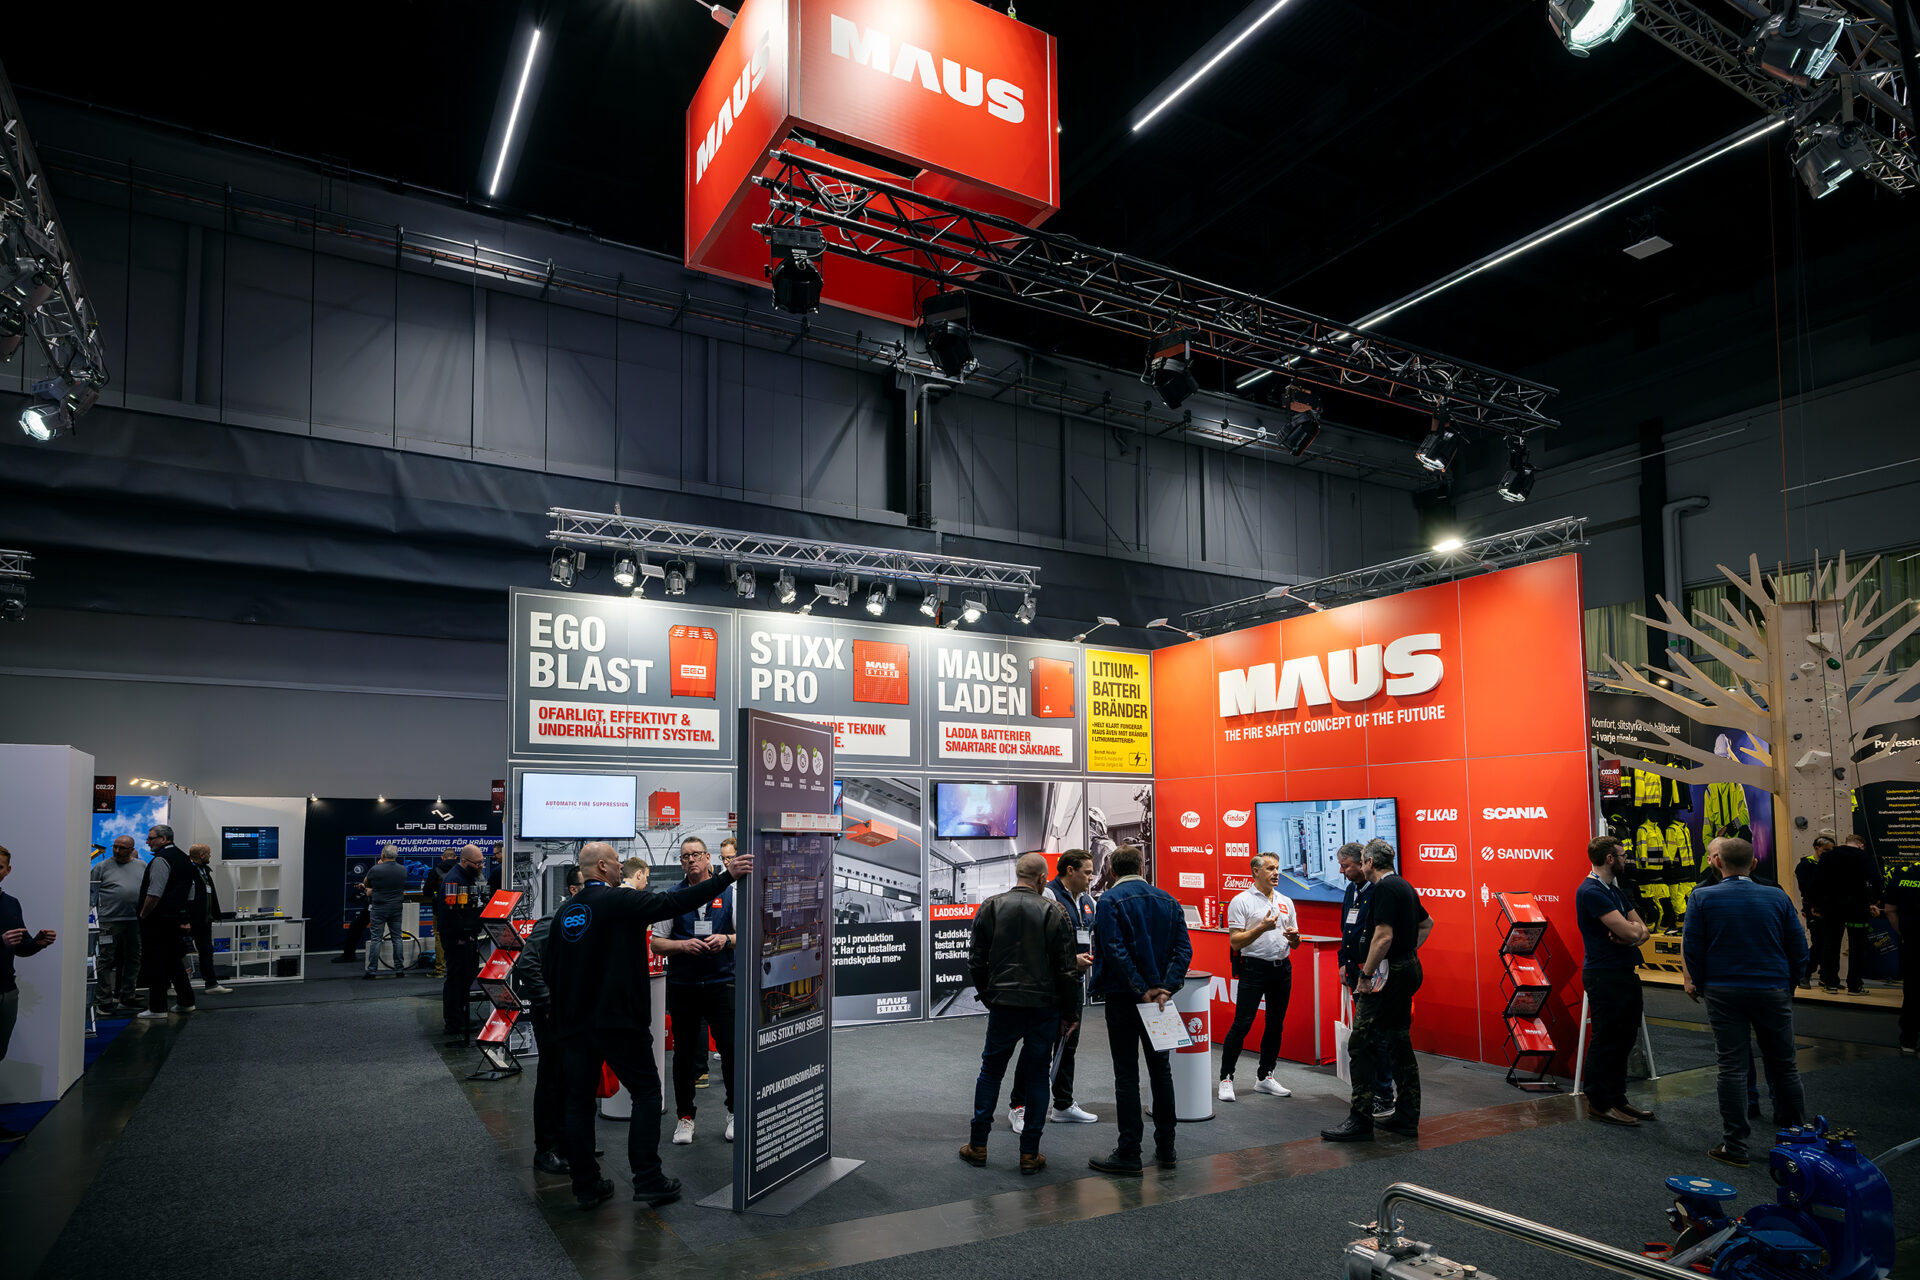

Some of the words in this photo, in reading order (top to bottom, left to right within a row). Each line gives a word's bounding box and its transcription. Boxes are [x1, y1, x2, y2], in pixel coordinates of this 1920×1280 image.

[831, 14, 1025, 124] MAUS
[696, 26, 770, 184] MAUS
[530, 612, 606, 652] EGO
[750, 631, 846, 670] STIXX
[866, 661, 895, 669] MAUS
[938, 648, 1018, 683] MAUS
[1092, 661, 1138, 679] LITIUM-
[530, 652, 654, 694] BLAST
[1218, 633, 1444, 718] MAUS
[752, 668, 818, 704] PRO
[1093, 680, 1140, 699] BATTERI
[938, 681, 1026, 716] LADEN
[538, 706, 606, 724] OFARLIGT,
[610, 710, 678, 725] EFFEKTIVT
[682, 714, 690, 726] &
[1093, 699, 1148, 719] BRÄNDER
[847, 722, 886, 736] TEKNIK
[1225, 729, 1241, 742] THE
[1244, 726, 1263, 740] FIRE
[1265, 722, 1301, 738] SAFETY
[1304, 716, 1351, 733] CONCEPT
[1355, 714, 1370, 727] OF
[1372, 711, 1394, 726] THE
[1397, 705, 1445, 722] FUTURE
[1592, 718, 1616, 730] Komfort,
[538, 721, 660, 740] UNDERHÅLLSFRITT
[662, 728, 715, 742] SYSTEM.
[946, 728, 978, 740] LADDA
[981, 729, 1031, 741] BATTERIER
[1600, 732, 1616, 744] varje
[946, 741, 996, 753] SMARTARE
[999, 743, 1017, 754] OCH
[1019, 742, 1063, 756] SÄKRARE.
[1427, 809, 1457, 821] LKAB
[1482, 807, 1548, 820] SCANIA
[1226, 844, 1249, 854] KONE
[1420, 847, 1456, 859] JULA
[1497, 849, 1554, 860] SANDVIK
[1224, 876, 1252, 888] Estrella
[1415, 888, 1466, 898] VOLVO
[934, 905, 974, 917] LADDSKÅP
[564, 914, 585, 928] ess
[852, 933, 893, 945] produktion
[935, 941, 955, 949] testat
[840, 946, 854, 954] Har
[856, 945, 866, 953] du
[868, 943, 906, 953] installerat
[936, 974, 963, 982] kiwa
[877, 997, 908, 1005] MAUS
[760, 1030, 777, 1046] MAUS
[778, 1025, 794, 1040] STIXX
[795, 1022, 805, 1035] PRO
[806, 1015, 823, 1031] SERIEN
